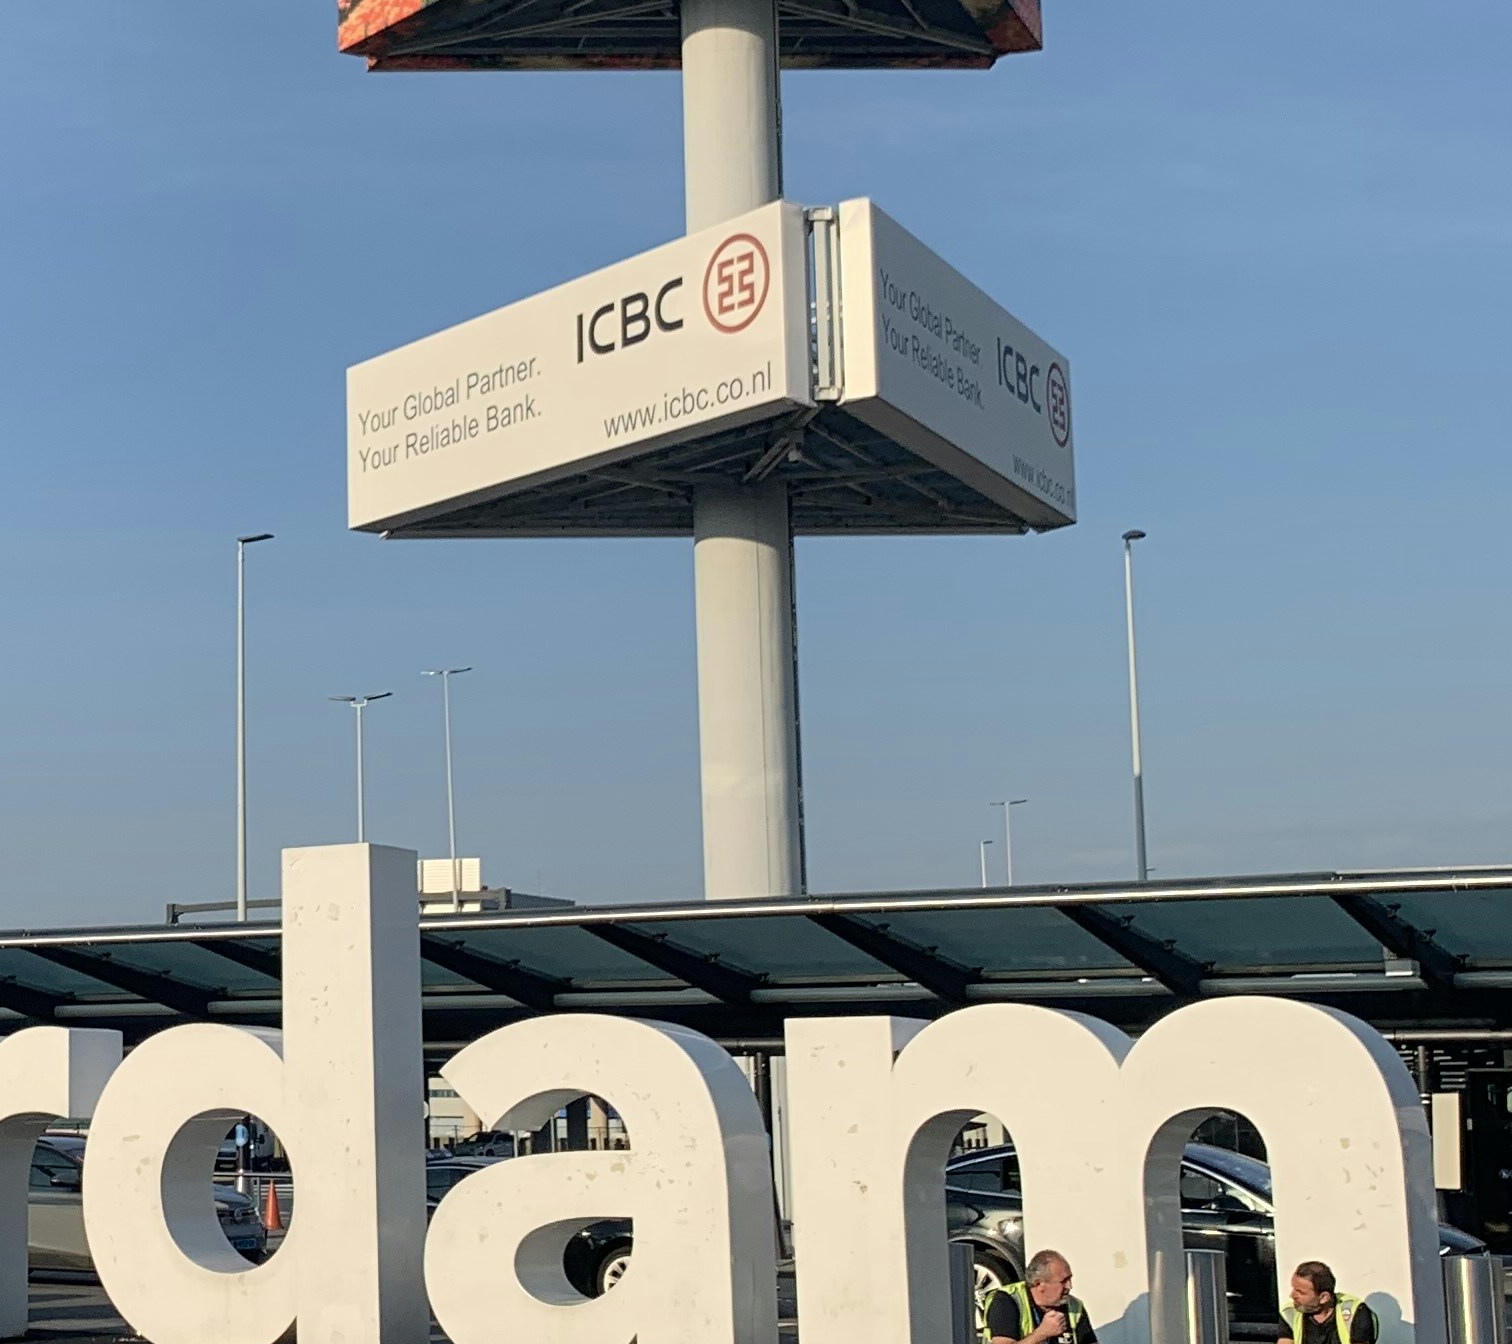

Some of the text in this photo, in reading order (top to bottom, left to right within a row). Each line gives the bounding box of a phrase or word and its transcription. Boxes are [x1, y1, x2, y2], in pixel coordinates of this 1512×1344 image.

[576, 276, 684, 365] ICBC
[879, 266, 907, 313] Your
[909, 290, 943, 340] Global
[881, 313, 909, 356] Your
[911, 335, 955, 389] Reliable
[996, 335, 1042, 415] ICBC
[358, 357, 542, 436] Your Global Partner.
[358, 393, 542, 473] Your Reliable Bank.
[603, 360, 772, 439] www.icbc.co.nl
